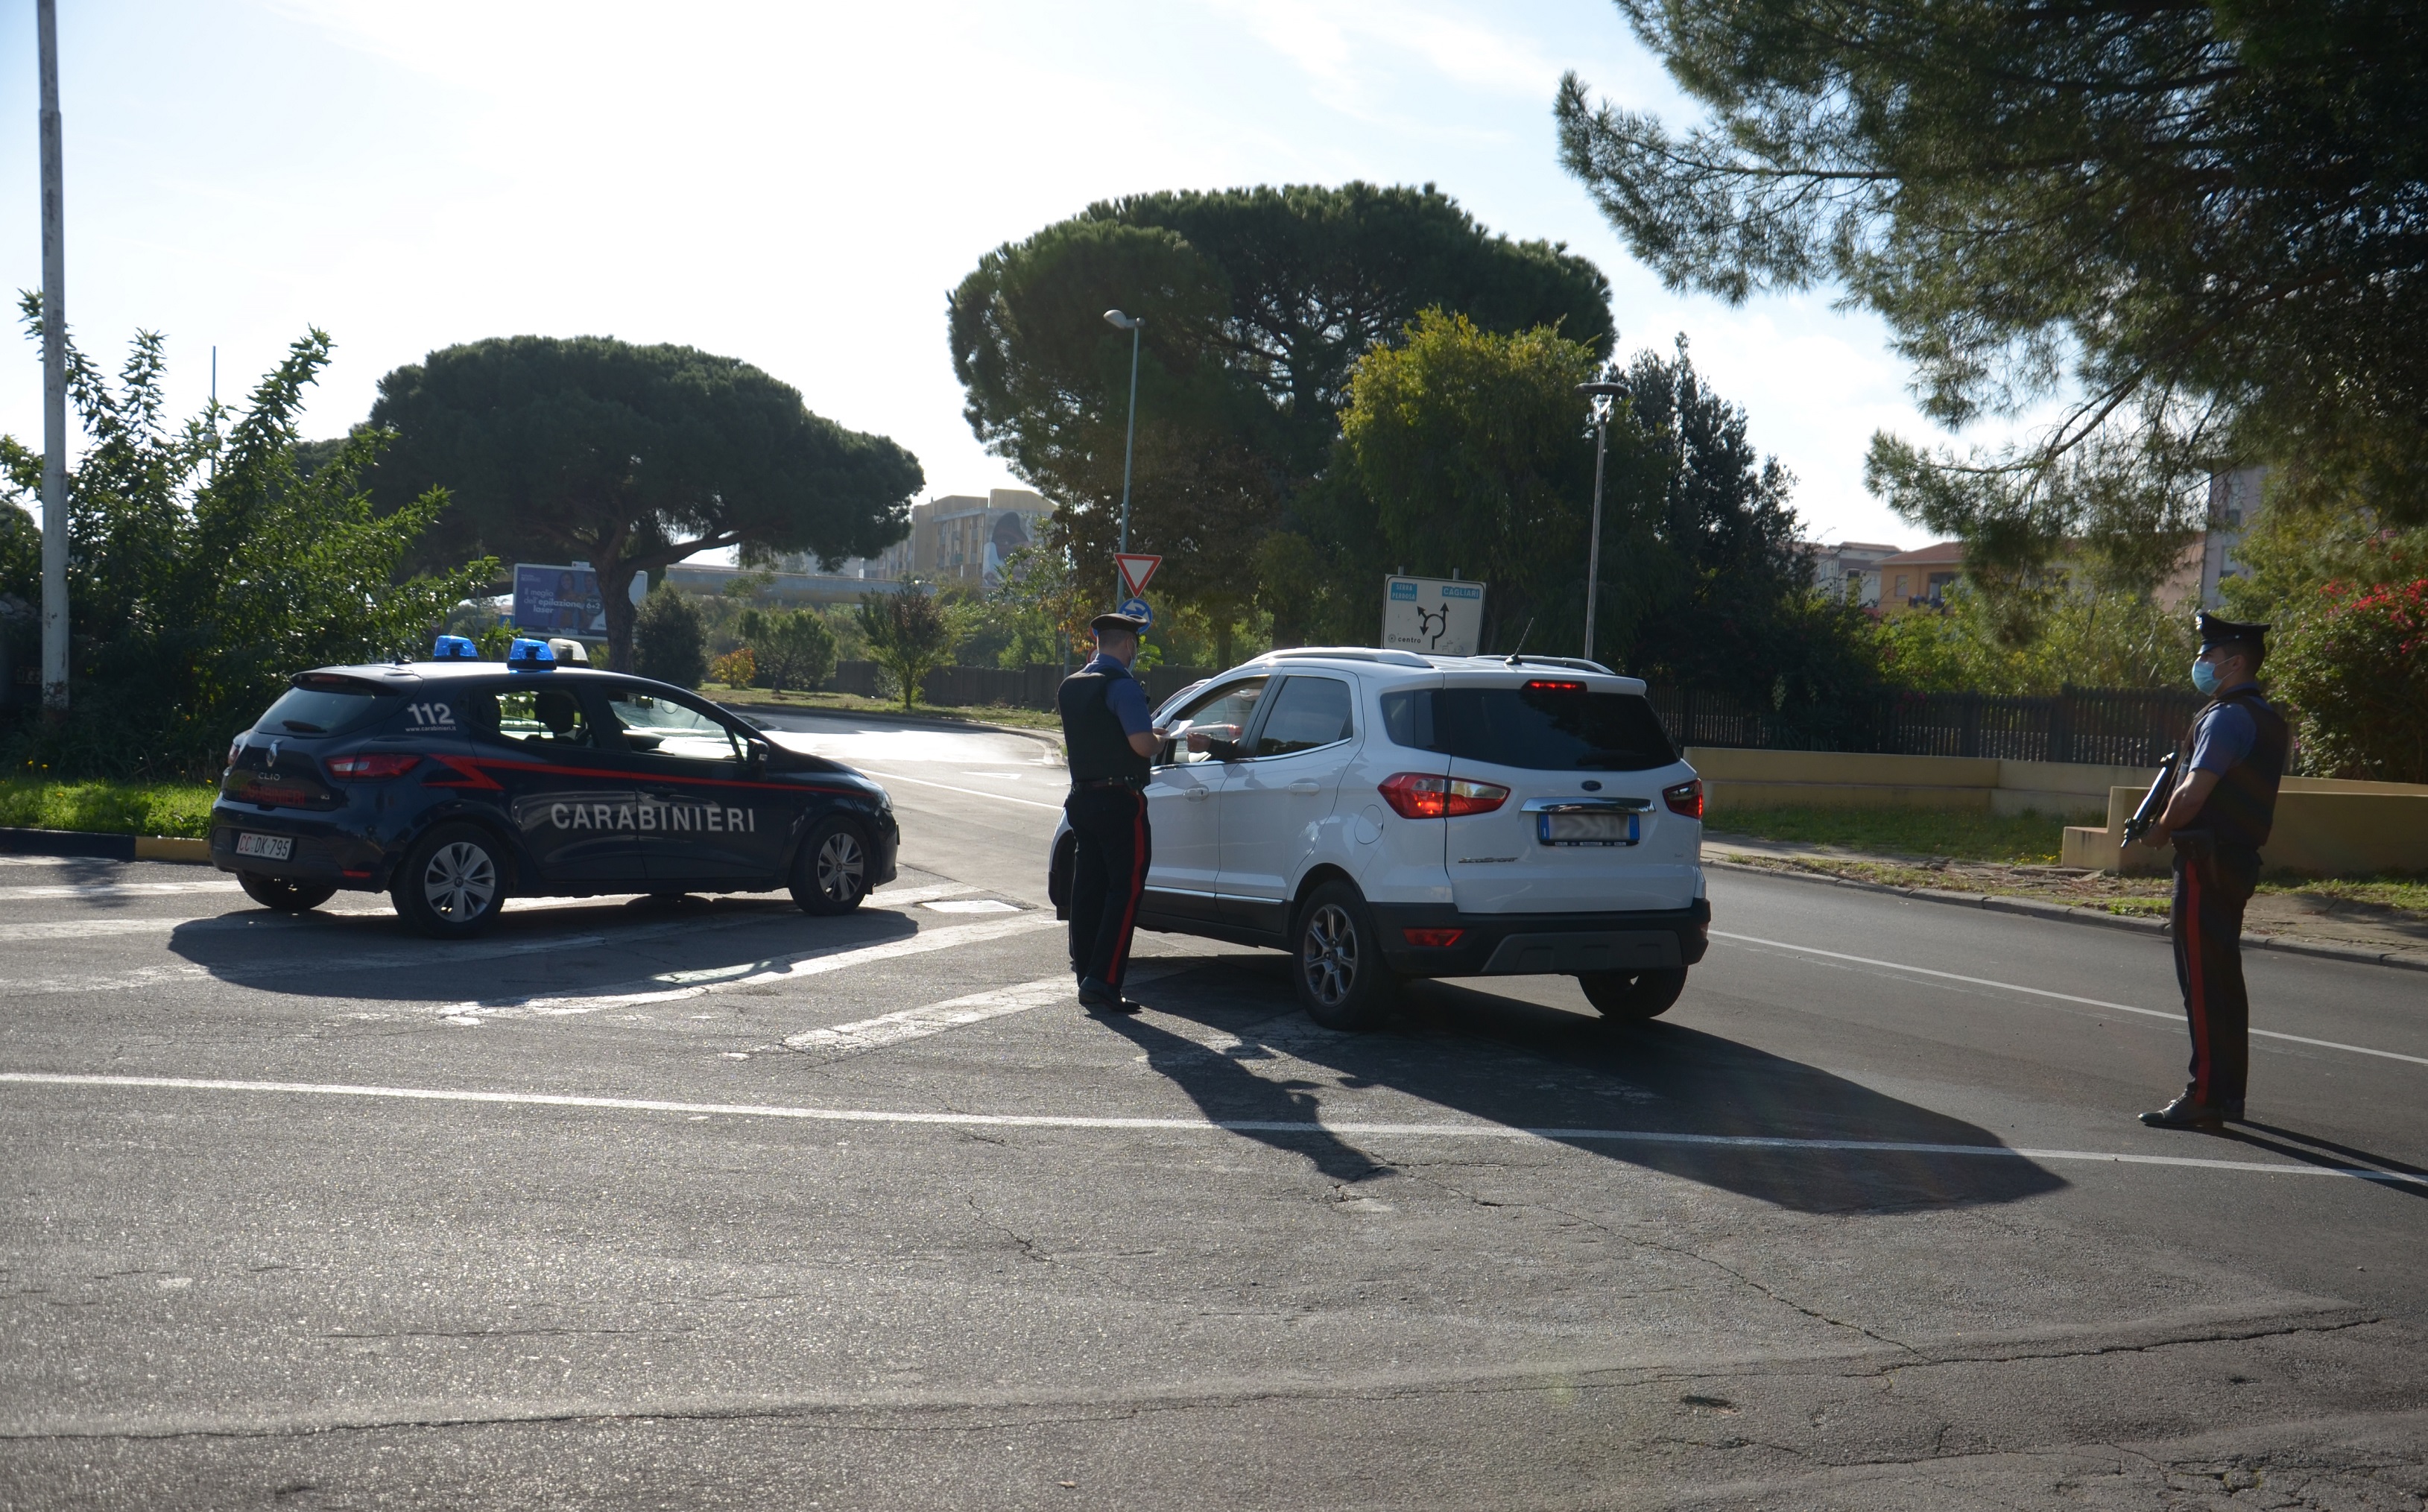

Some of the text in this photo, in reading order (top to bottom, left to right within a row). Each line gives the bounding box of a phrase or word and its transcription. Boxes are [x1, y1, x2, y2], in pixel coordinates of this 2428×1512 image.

[1396, 583, 1413, 592] SERRA
[1444, 587, 1479, 598] CAGLIARI
[530, 589, 554, 598] meglio
[533, 604, 554, 613] laser
[406, 703, 455, 725] 112
[258, 772, 281, 781] CLIO
[550, 803, 755, 832] CARABINIERI
[238, 835, 290, 857] CC DK 795
